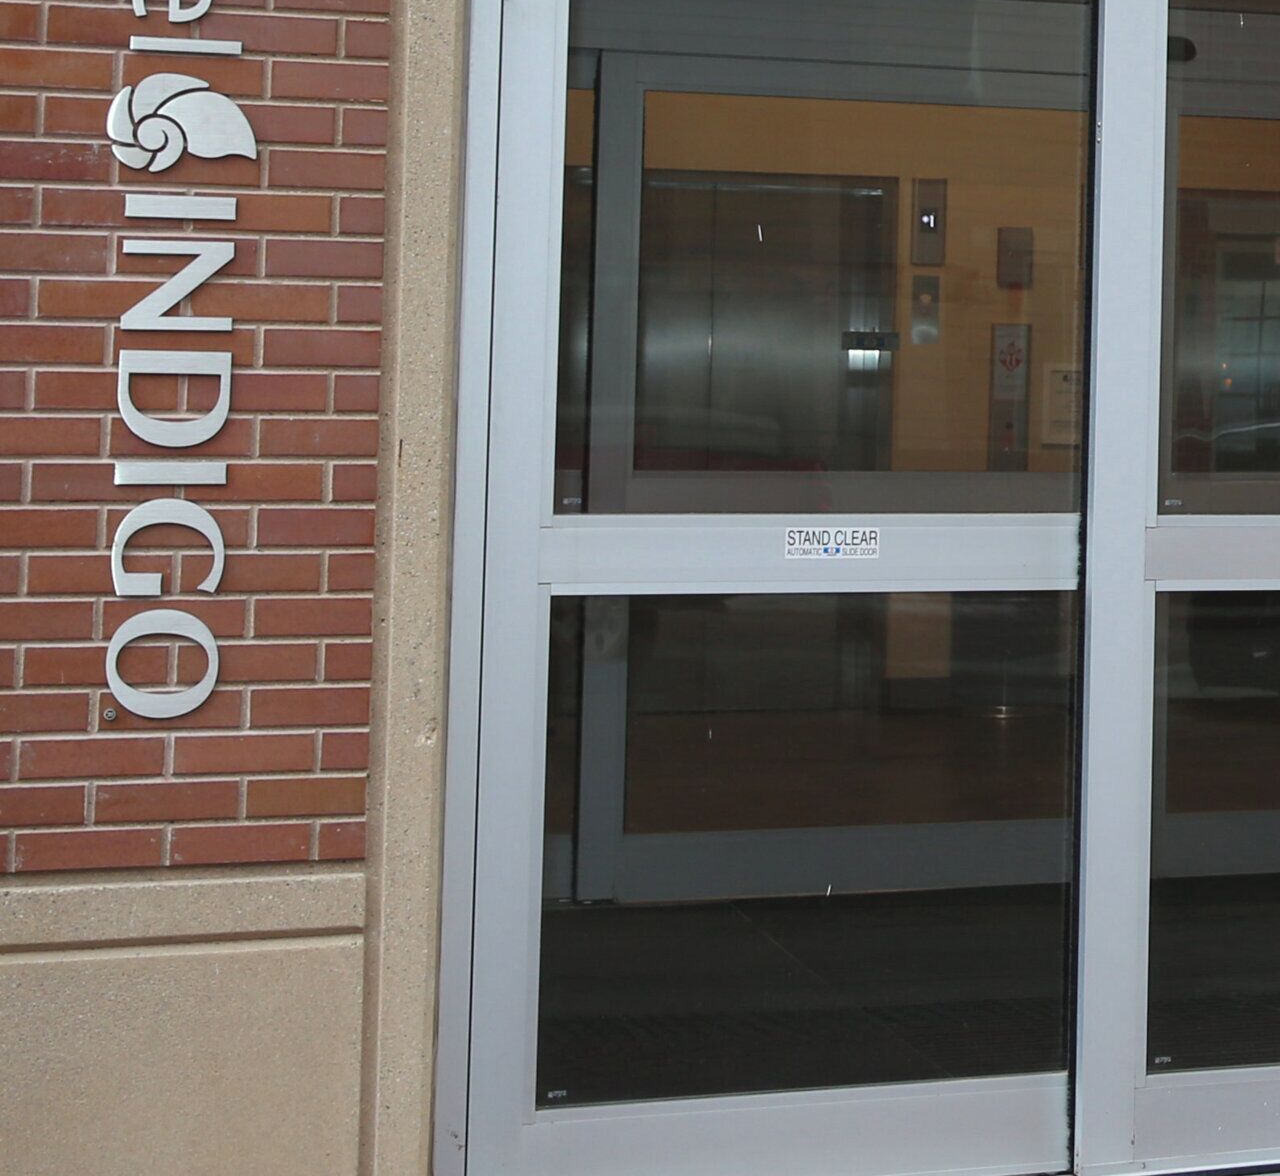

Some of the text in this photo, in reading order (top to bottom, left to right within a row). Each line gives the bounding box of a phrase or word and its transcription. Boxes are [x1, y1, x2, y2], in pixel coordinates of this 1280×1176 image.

[105, 192, 237, 721] INDIGO
[787, 530, 878, 546] STAND CLEAR
[787, 547, 822, 556] AUTOMATIC
[842, 547, 859, 556] SLIDE
